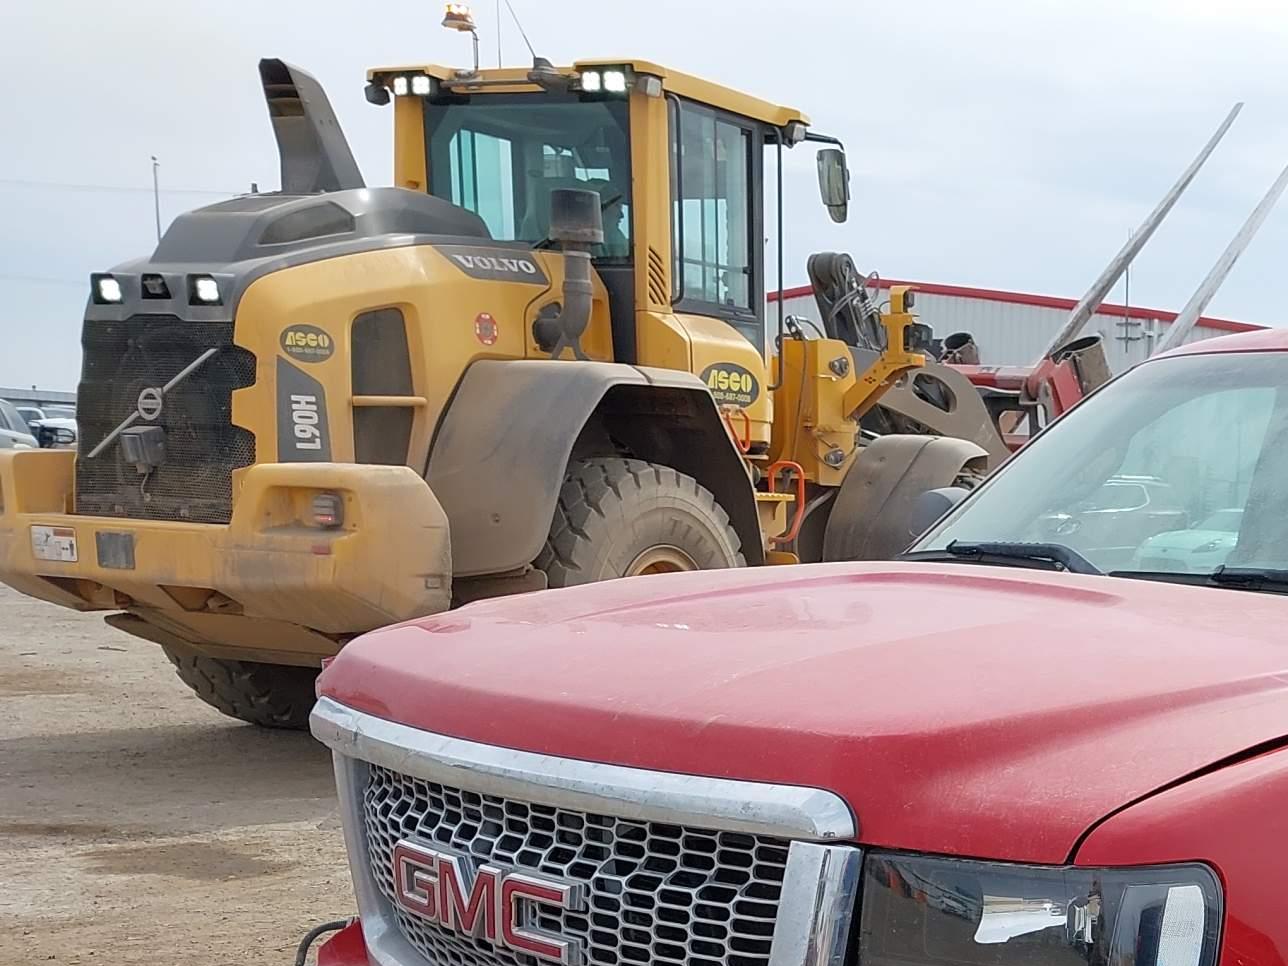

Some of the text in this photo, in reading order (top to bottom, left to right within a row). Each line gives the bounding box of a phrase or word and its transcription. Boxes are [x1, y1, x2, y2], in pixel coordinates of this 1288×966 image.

[451, 254, 536, 274] VOLVO
[285, 331, 330, 348] ASCO
[708, 369, 752, 393] ASCO
[290, 394, 322, 450] L90H
[393, 839, 580, 966] GMC
